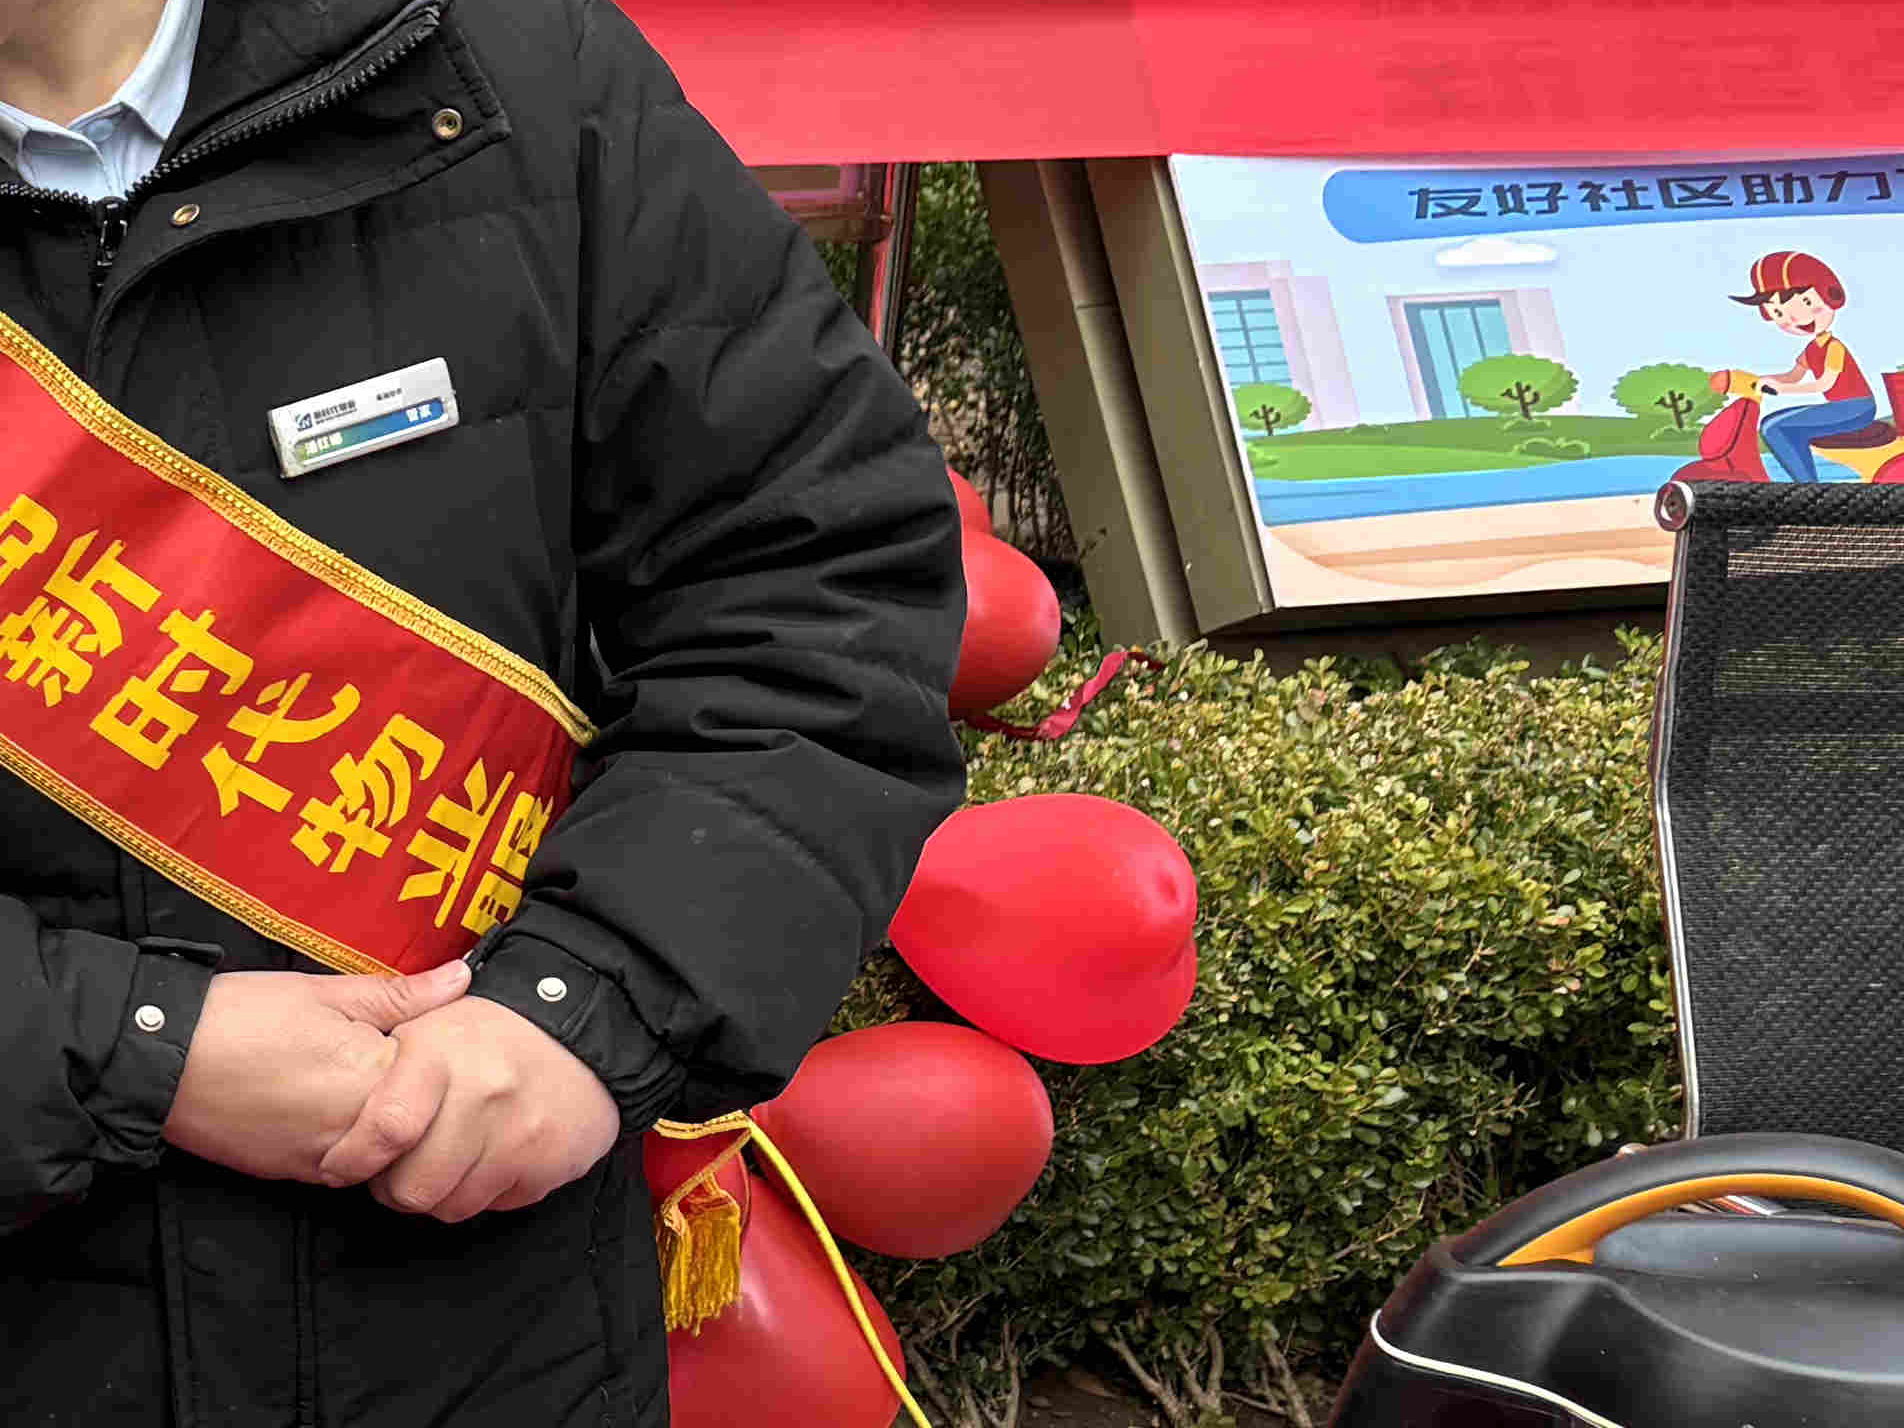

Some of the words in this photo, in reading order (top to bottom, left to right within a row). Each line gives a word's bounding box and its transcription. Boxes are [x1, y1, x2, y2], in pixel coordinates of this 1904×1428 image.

[1407, 169, 1904, 220] 友好社区助力
